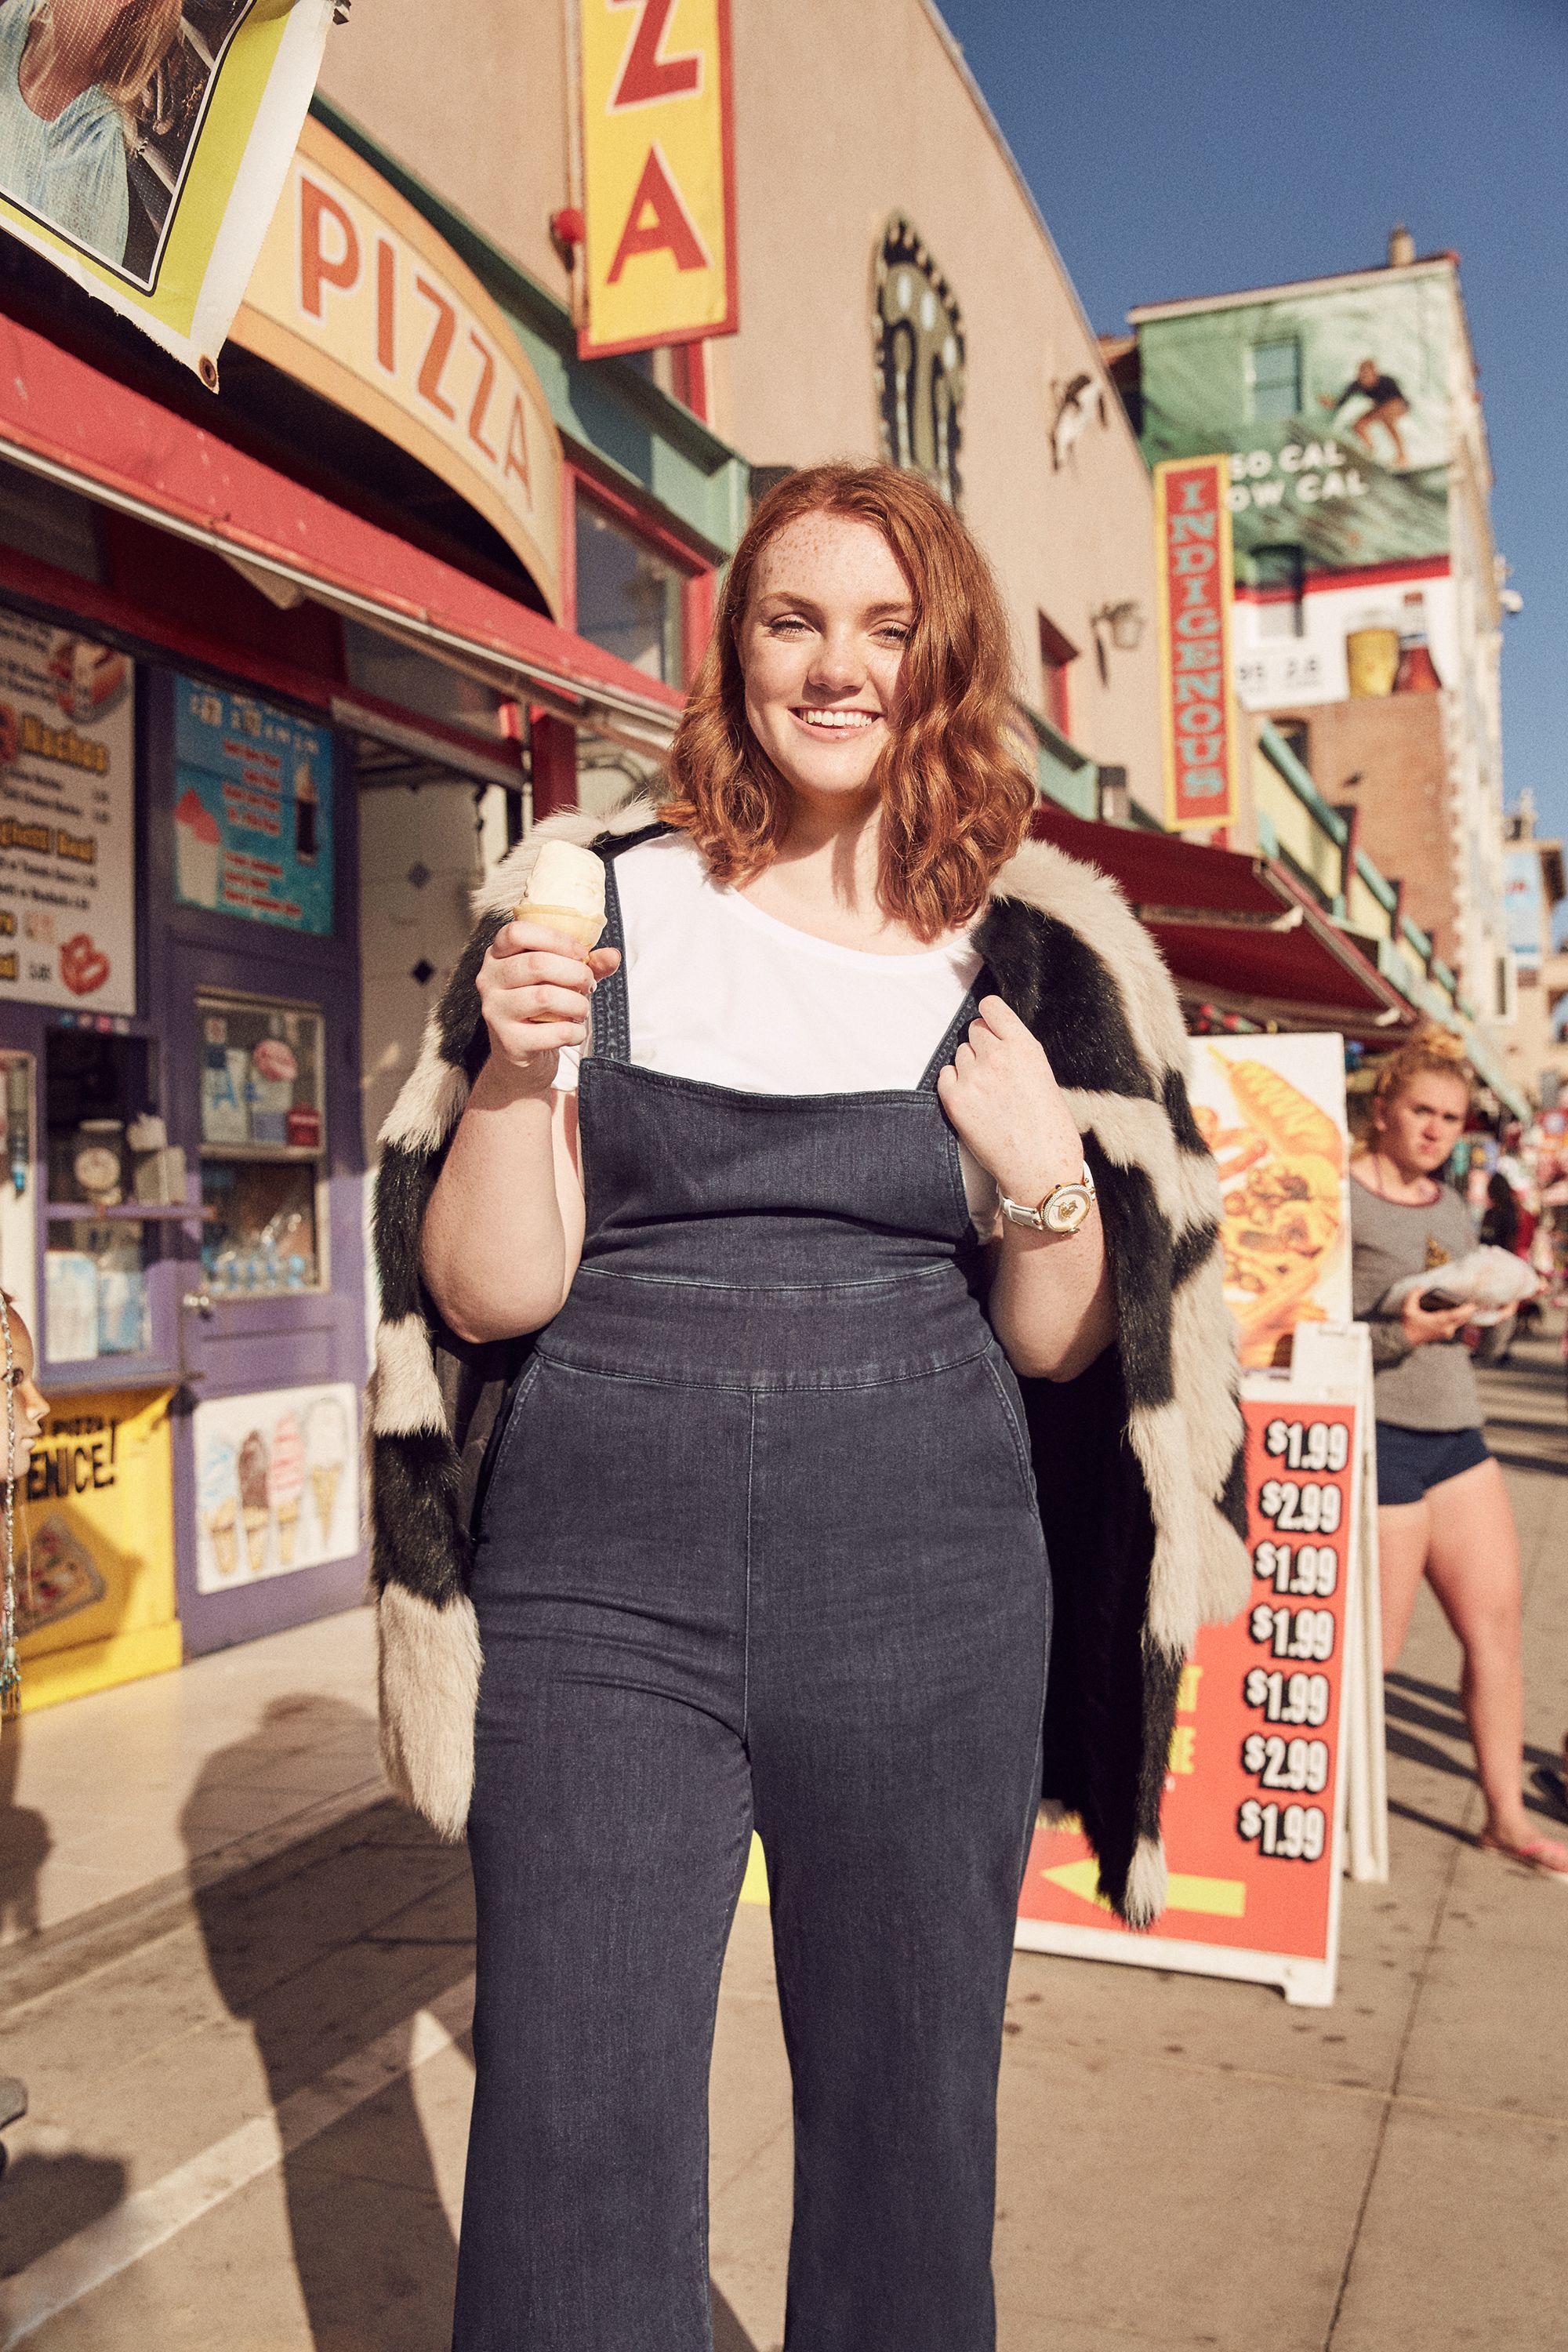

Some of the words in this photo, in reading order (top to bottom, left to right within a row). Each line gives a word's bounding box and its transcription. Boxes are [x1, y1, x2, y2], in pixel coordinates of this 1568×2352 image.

[301, 176, 532, 511] PIZZA
[1278, 441, 1345, 472] CAL
[1227, 480, 1286, 511] OW
[1295, 470, 1369, 503] CAL
[1171, 480, 1225, 798] INDIGENOUS
[27, 1417, 114, 1501] ENICE!
[1265, 1419, 1349, 1472] $1.99
[1259, 1479, 1342, 1534] $2.99
[1254, 1541, 1338, 1598] $1.99
[1250, 1604, 1335, 1661] $1.99
[1244, 1668, 1330, 1726] $1.99
[1243, 1733, 1329, 1793] $2.99
[1238, 1799, 1326, 1861] $1.99
